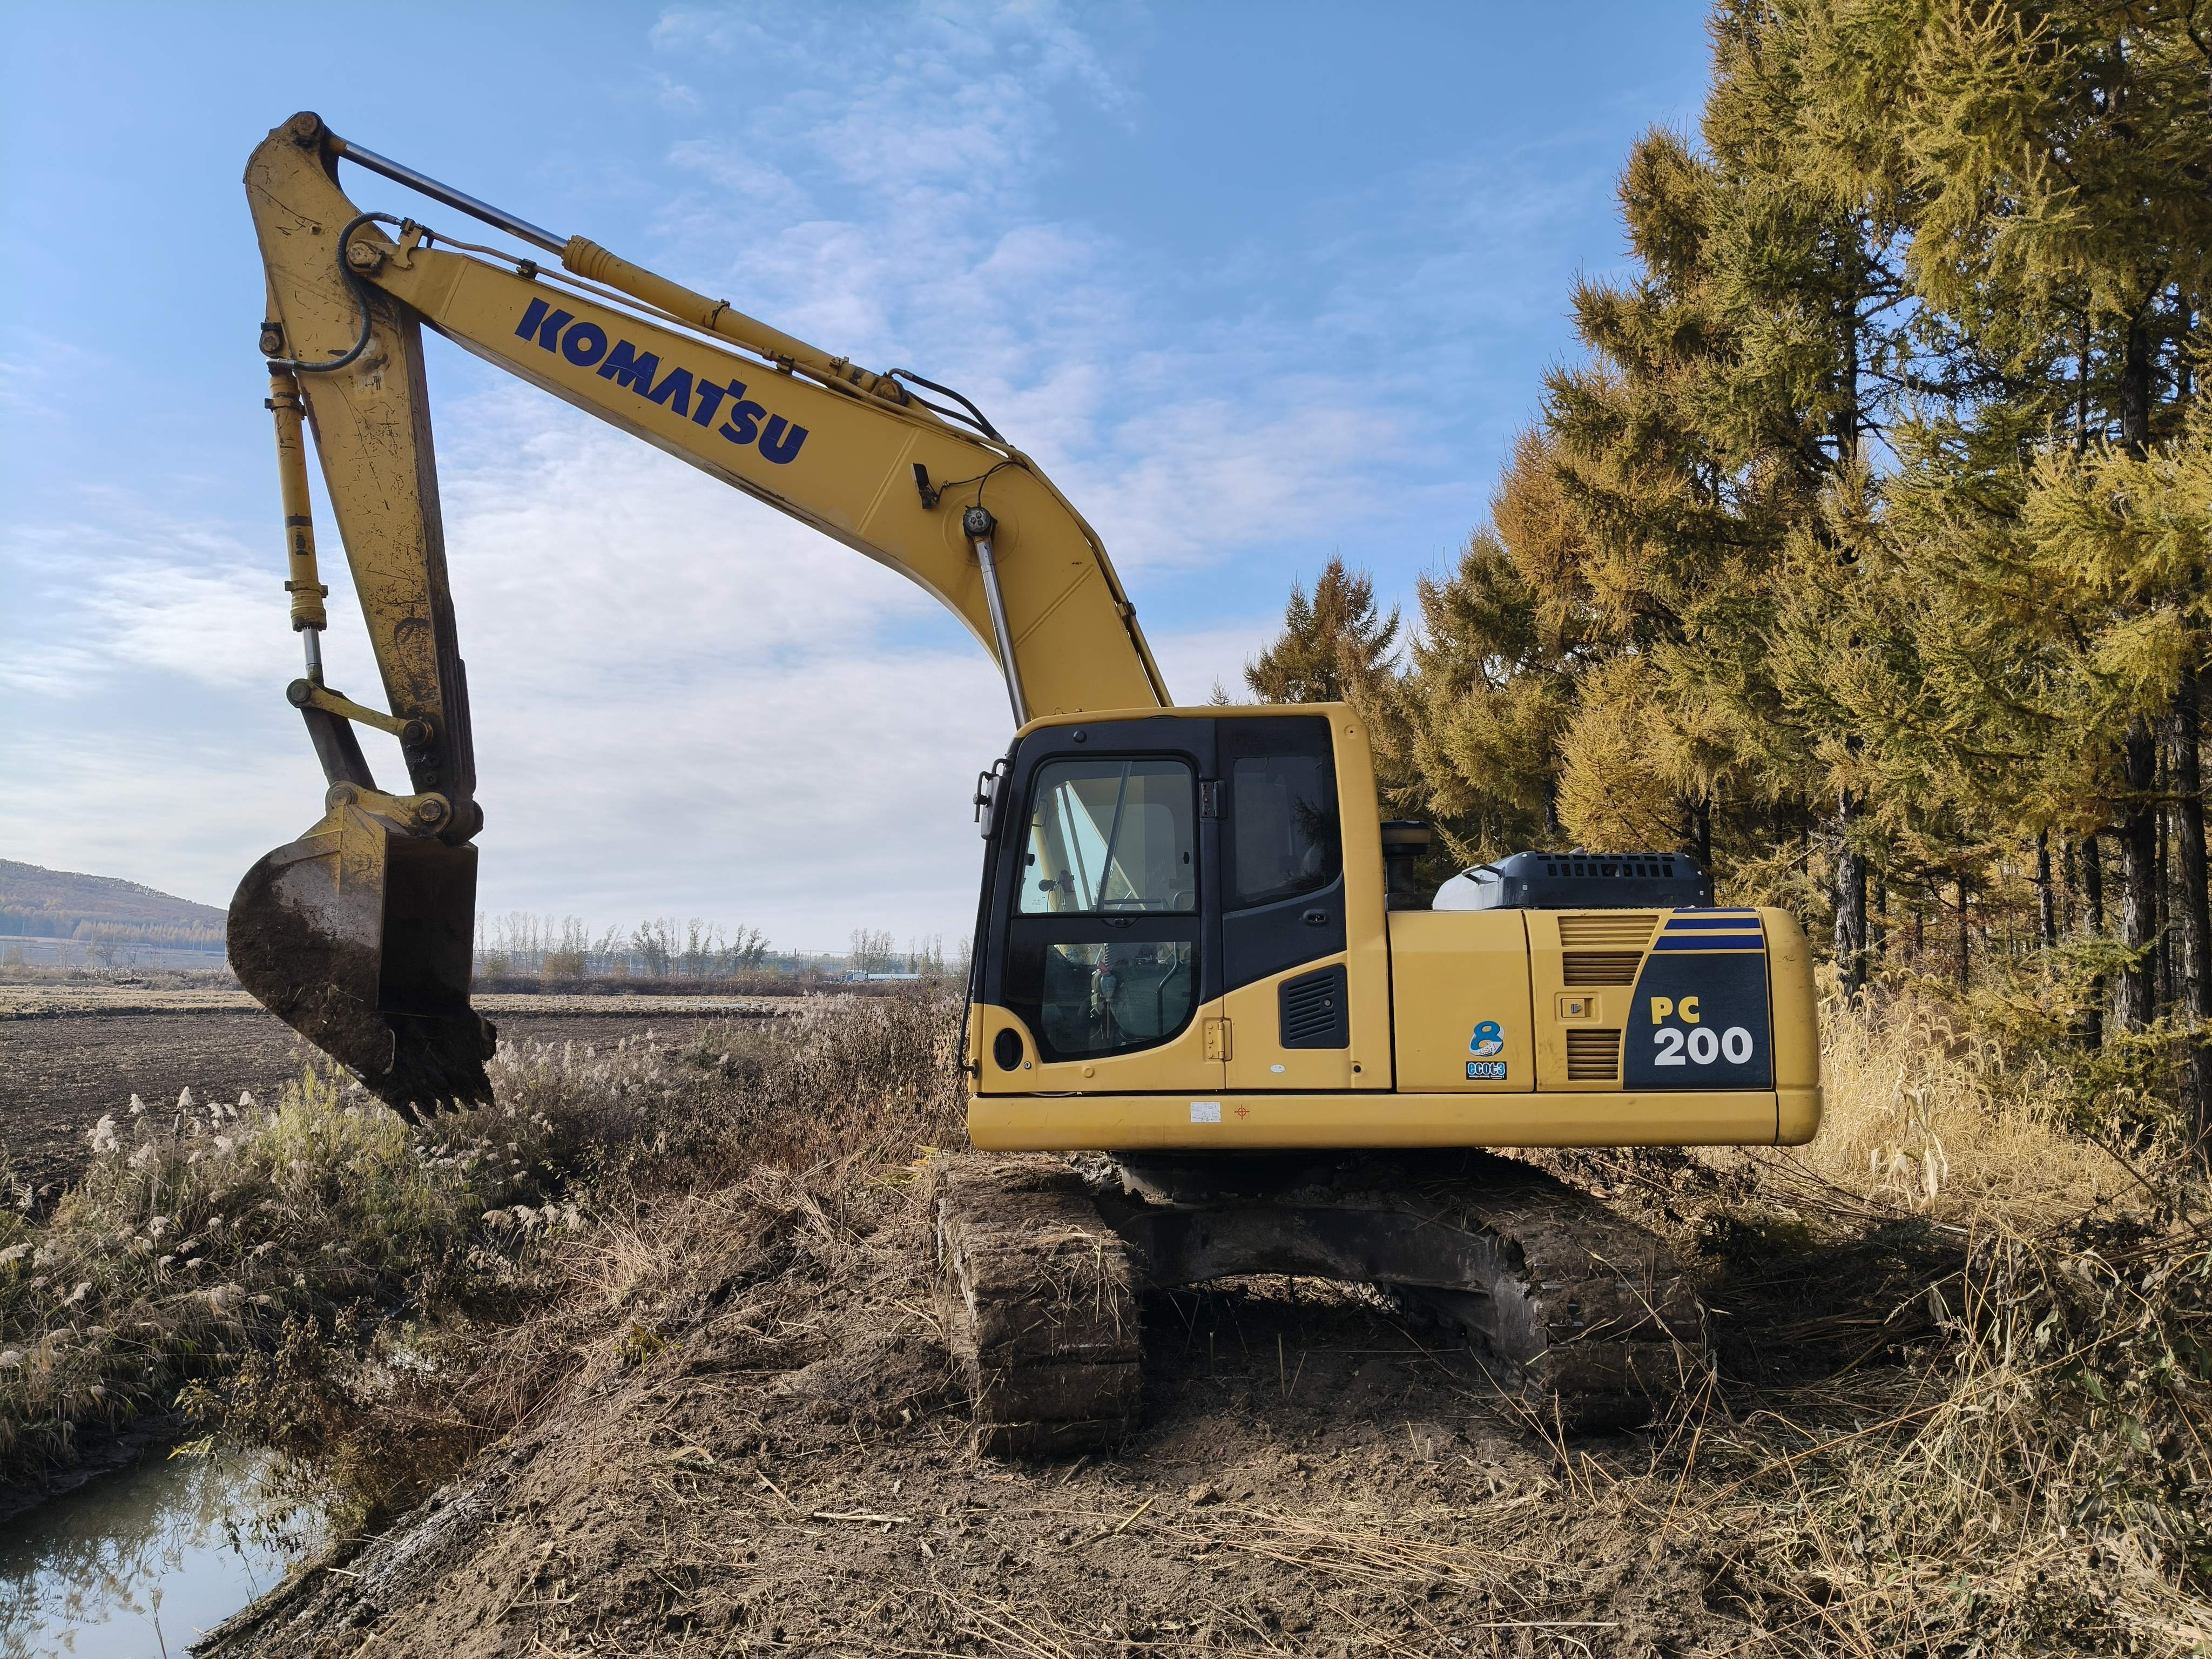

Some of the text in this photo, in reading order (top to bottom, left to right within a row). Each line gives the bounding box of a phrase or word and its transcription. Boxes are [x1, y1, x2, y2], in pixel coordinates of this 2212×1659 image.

[514, 296, 809, 464] KOMATSU
[1651, 996, 1700, 1024] PC
[1470, 1021, 1503, 1056] 8
[1654, 1027, 1753, 1065] 200
[1468, 1062, 1505, 1075] ecot3
